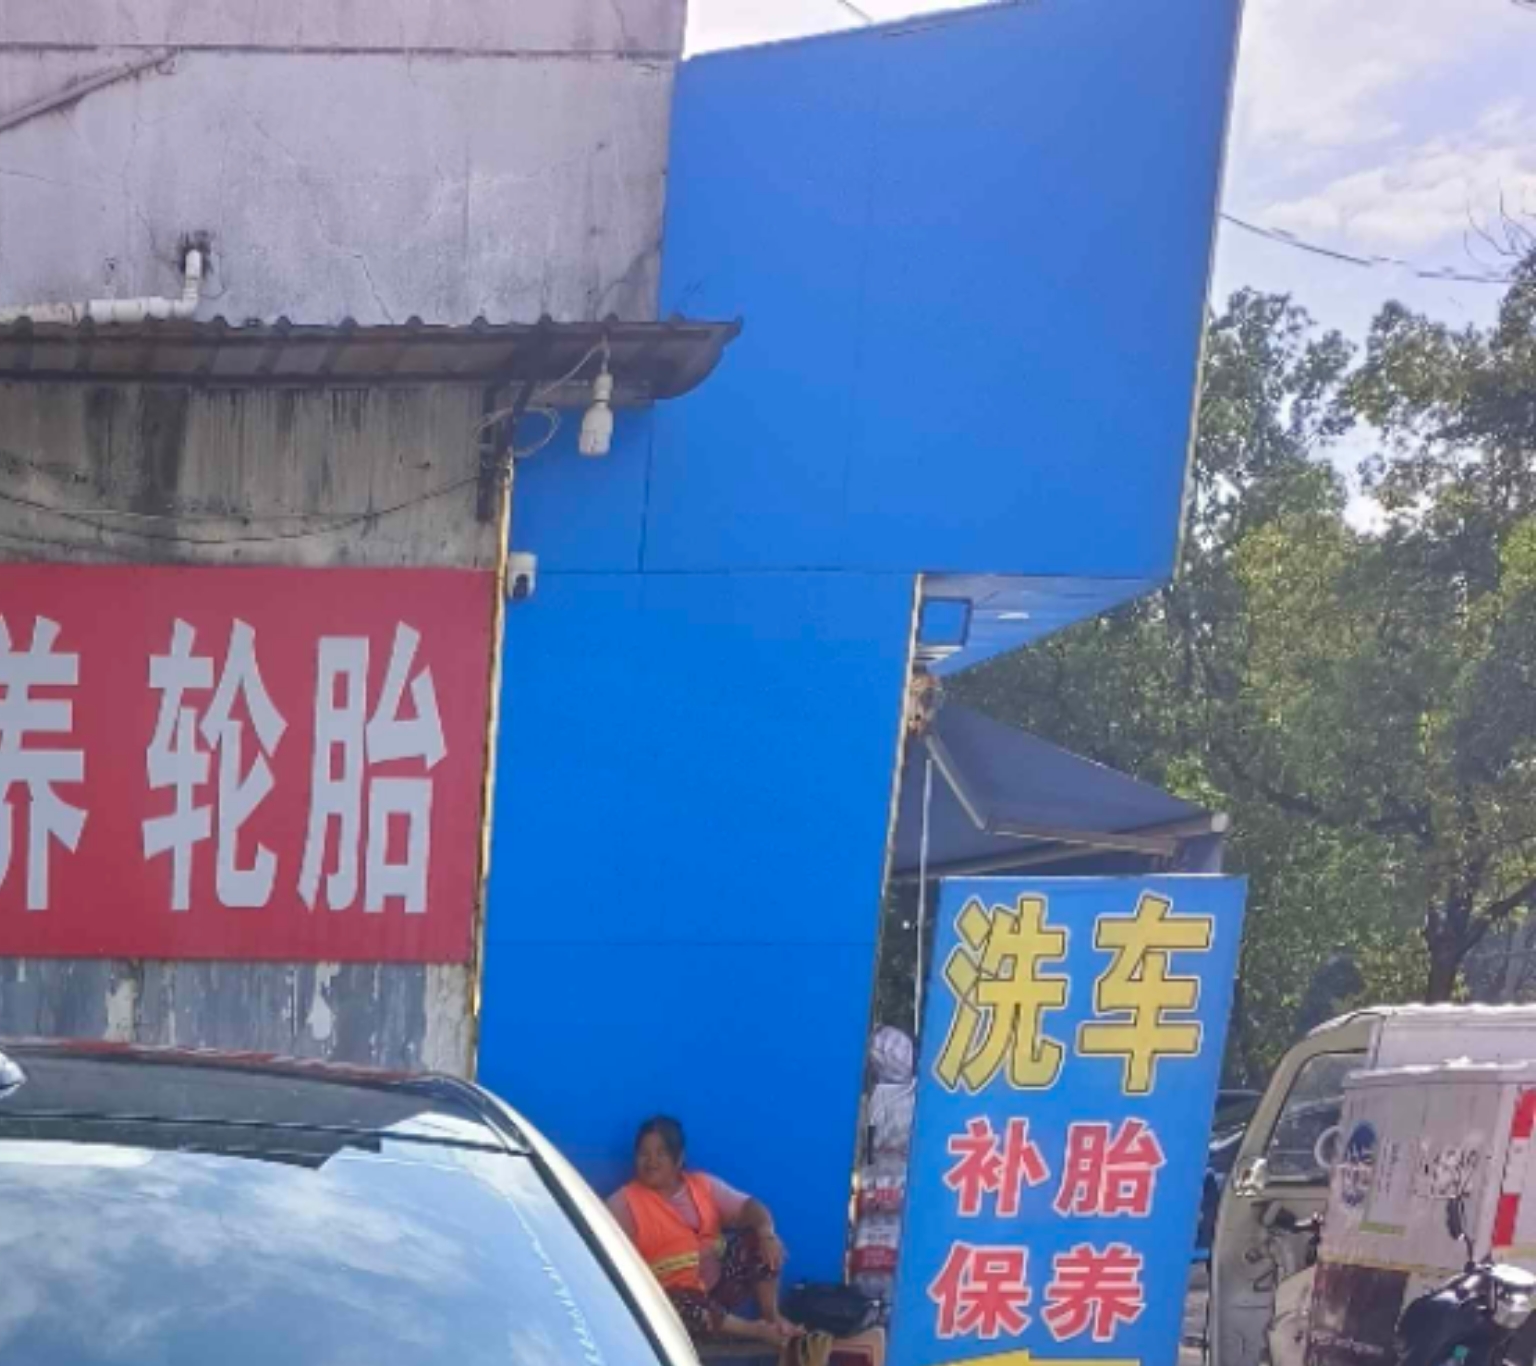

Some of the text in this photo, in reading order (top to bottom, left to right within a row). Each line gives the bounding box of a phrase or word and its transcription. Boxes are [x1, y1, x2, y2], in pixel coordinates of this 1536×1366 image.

[143, 616, 448, 914] 轮胎
[932, 891, 1215, 1096] 洗车
[942, 1116, 1166, 1219] 补胎
[928, 1240, 1148, 1341] 保养
